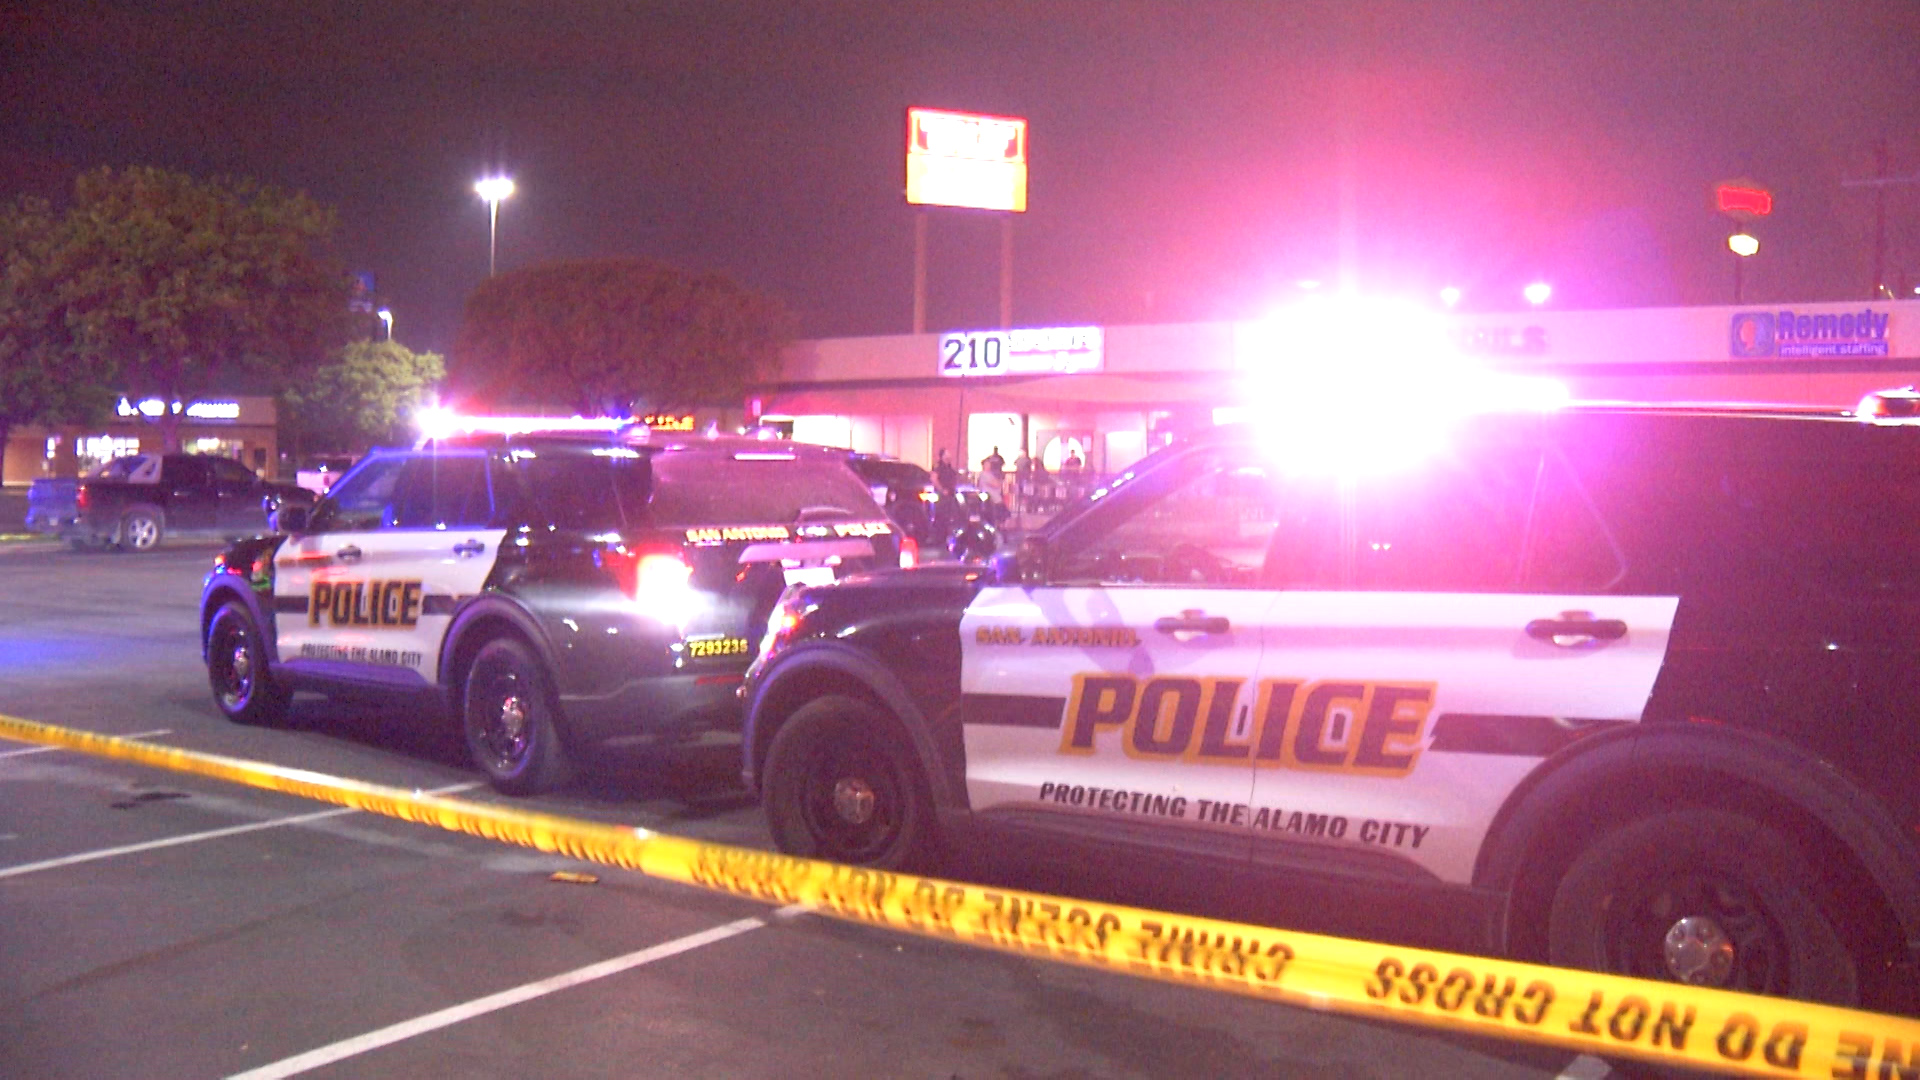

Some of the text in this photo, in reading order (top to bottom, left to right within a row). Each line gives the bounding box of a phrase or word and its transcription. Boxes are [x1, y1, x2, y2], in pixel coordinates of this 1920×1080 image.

[1779, 308, 1888, 339] Remedy
[1780, 342, 1887, 357] intelligent staffing
[944, 337, 1000, 369] 210
[686, 528, 722, 543] SAN
[723, 526, 790, 541] ANTONIO
[833, 523, 892, 538] POLICE
[309, 578, 423, 630] POLICE
[351, 646, 367, 662] THE
[401, 651, 422, 667] CITY
[975, 625, 1025, 646] SAN
[1058, 672, 1438, 777] POLICE
[1040, 781, 1430, 849] PROTECTING THE ALAMO CITY
[975, 892, 1121, 962] SCENE
[1137, 920, 1295, 987] CRIME
[1365, 957, 1555, 1025] CROSS
[1569, 990, 1697, 1050] NOT
[1716, 1013, 1808, 1069] DO
